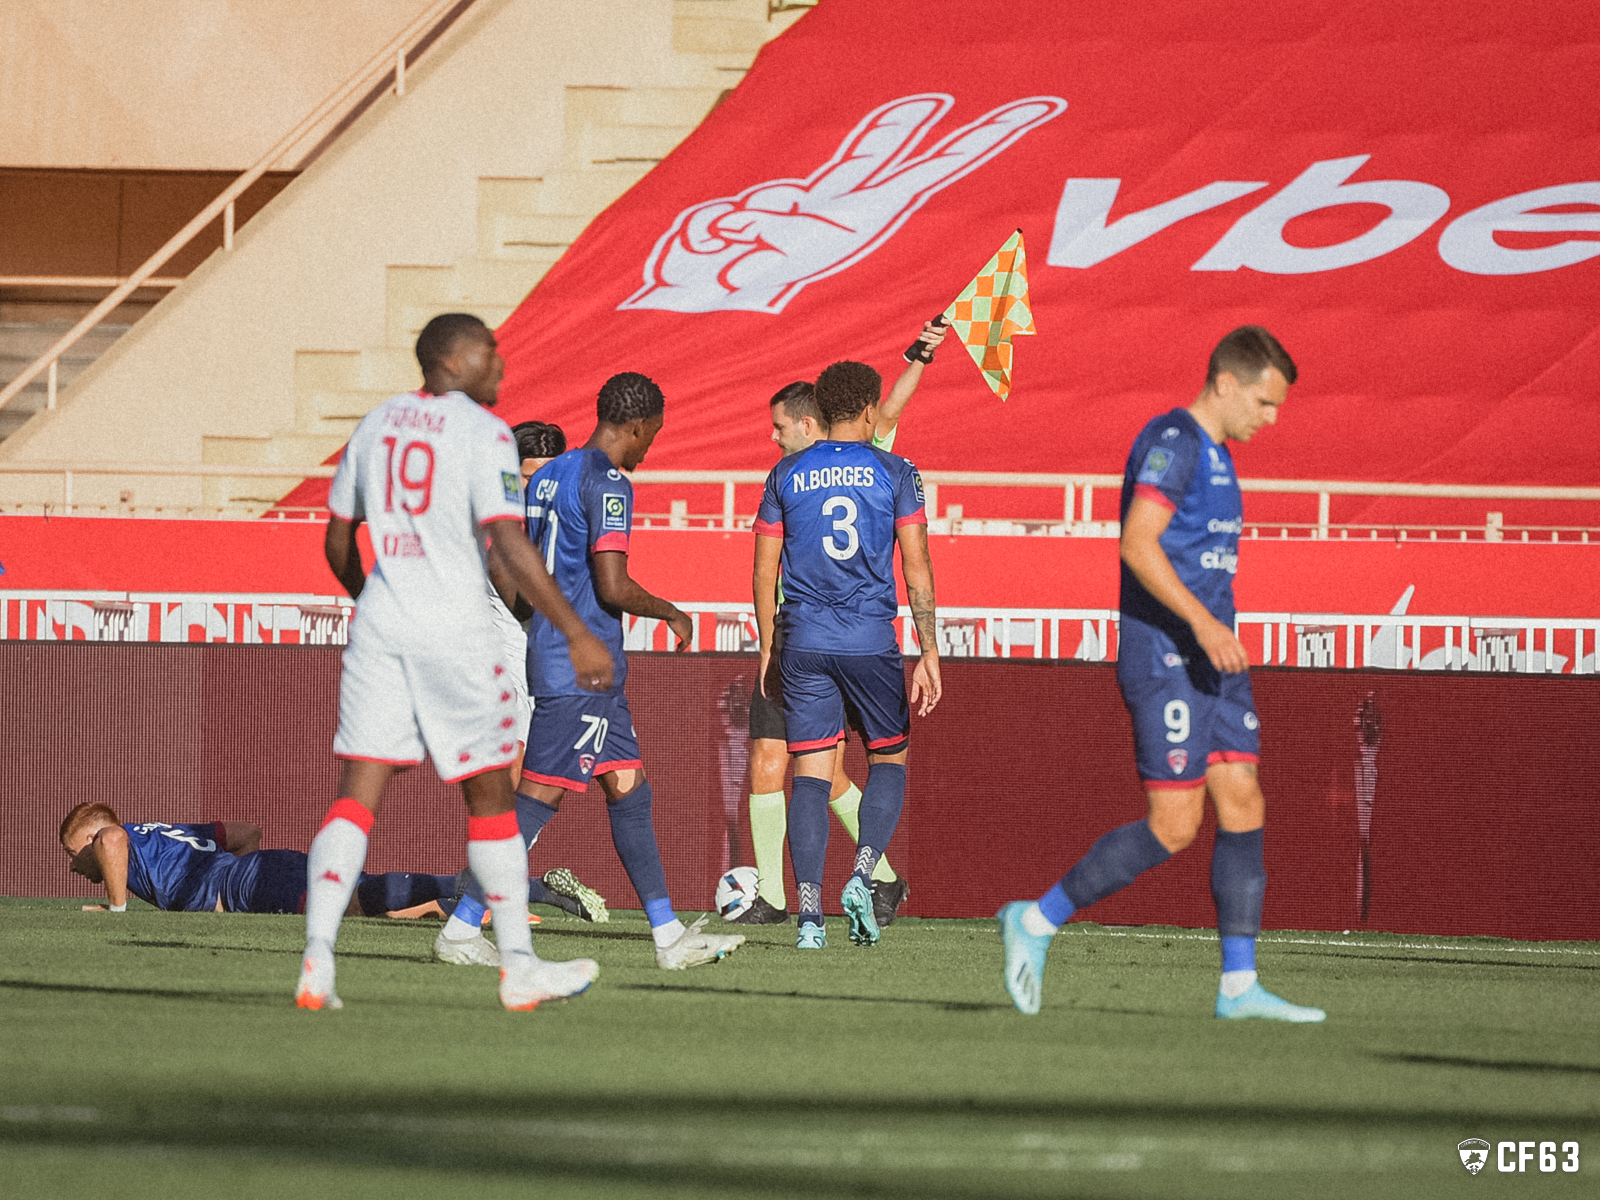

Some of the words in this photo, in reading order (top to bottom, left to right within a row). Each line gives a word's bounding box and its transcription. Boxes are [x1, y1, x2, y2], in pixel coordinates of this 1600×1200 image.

[382, 436, 436, 516] 19
[793, 466, 875, 494] N.BORGES
[822, 495, 859, 561] 3
[573, 714, 609, 754] 70
[1164, 698, 1191, 744] 9
